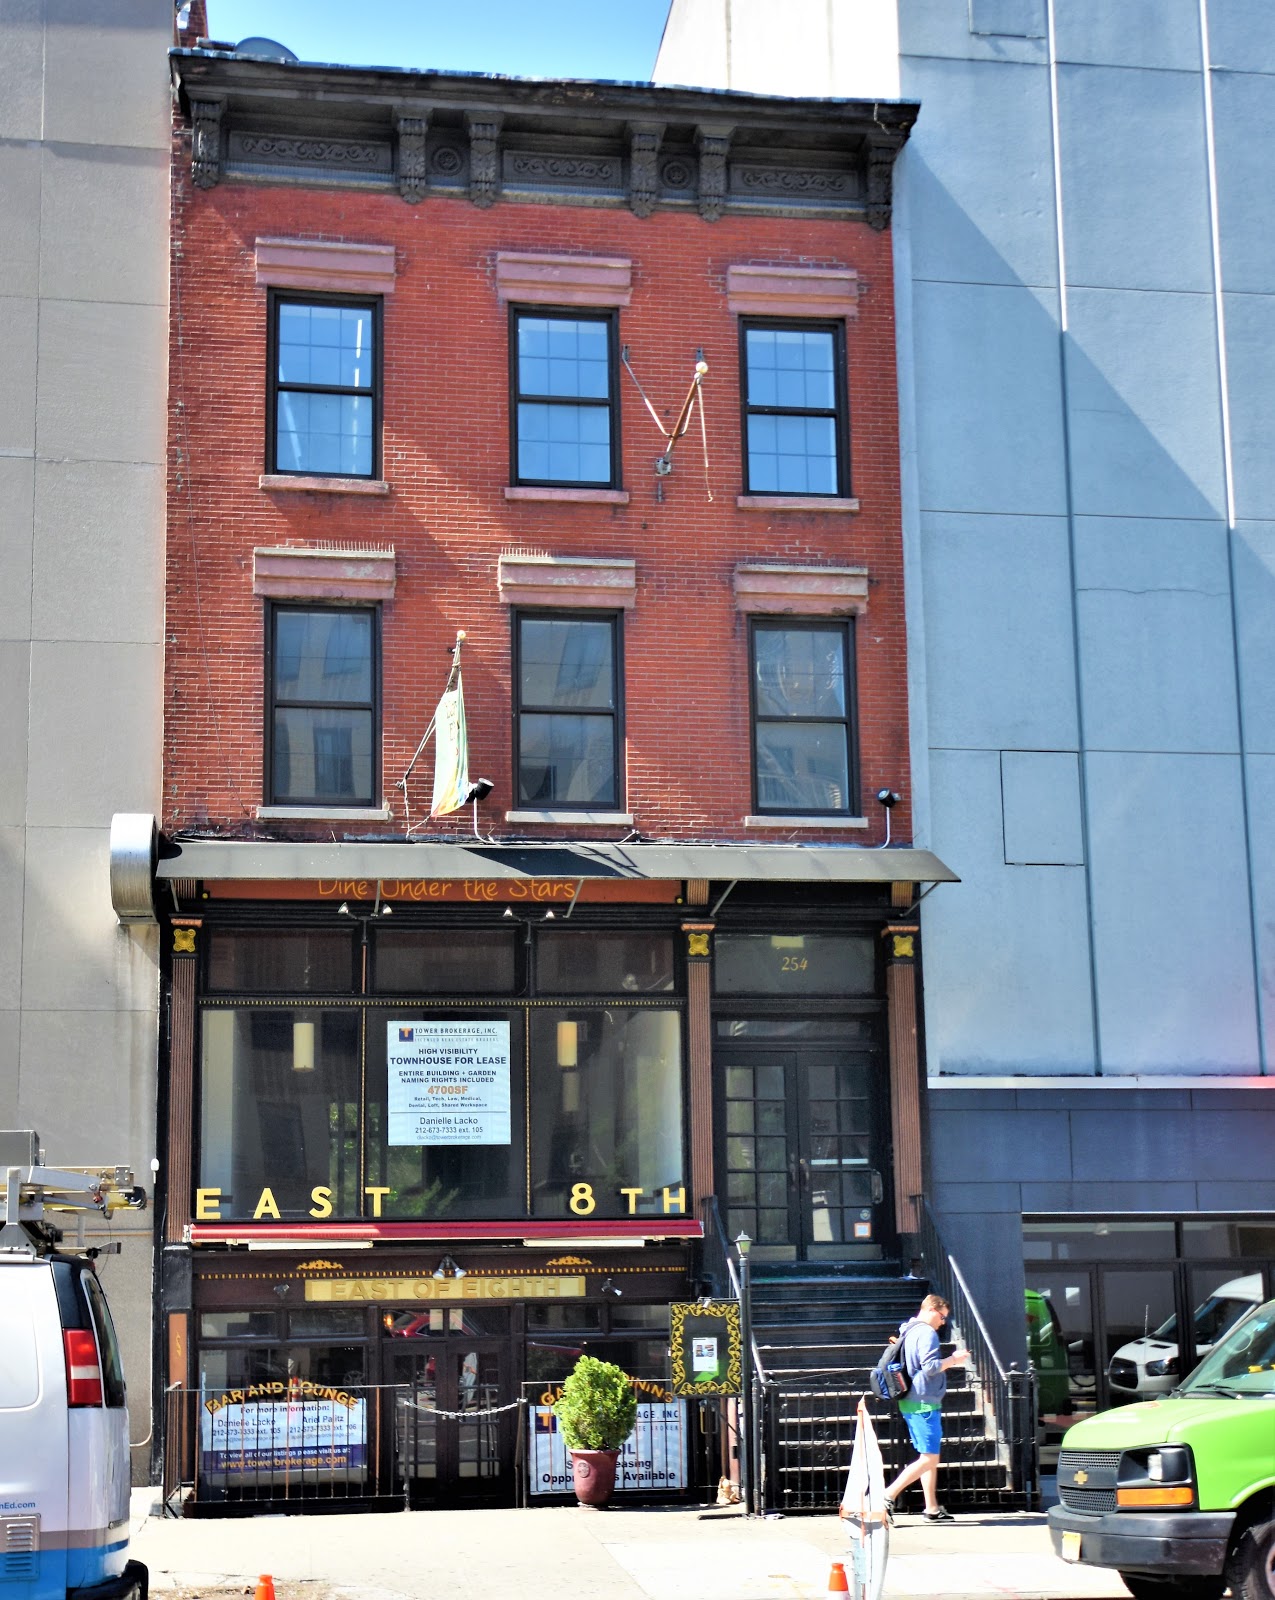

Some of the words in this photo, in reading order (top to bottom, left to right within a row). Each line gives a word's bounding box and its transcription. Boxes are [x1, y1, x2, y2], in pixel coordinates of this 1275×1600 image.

[318, 880, 368, 899] Dine
[380, 880, 451, 900] Under
[464, 880, 498, 900] the
[509, 880, 576, 901] Stars
[782, 956, 808, 971] 254
[428, 1086, 468, 1094] 4700SF
[196, 1186, 390, 1219] EAST
[570, 1183, 686, 1215] 8TH
[332, 1278, 404, 1300] EAST
[413, 1278, 450, 1298] OF
[462, 1277, 560, 1298] EIGHTH
[205, 1390, 243, 1414] BAR
[248, 1382, 284, 1396] AND
[289, 1378, 359, 1410] LOUNGE
[290, 1425, 330, 1433] 212-673-333
[616, 1459, 652, 1469] easing
[624, 1471, 675, 1480] Availabe
